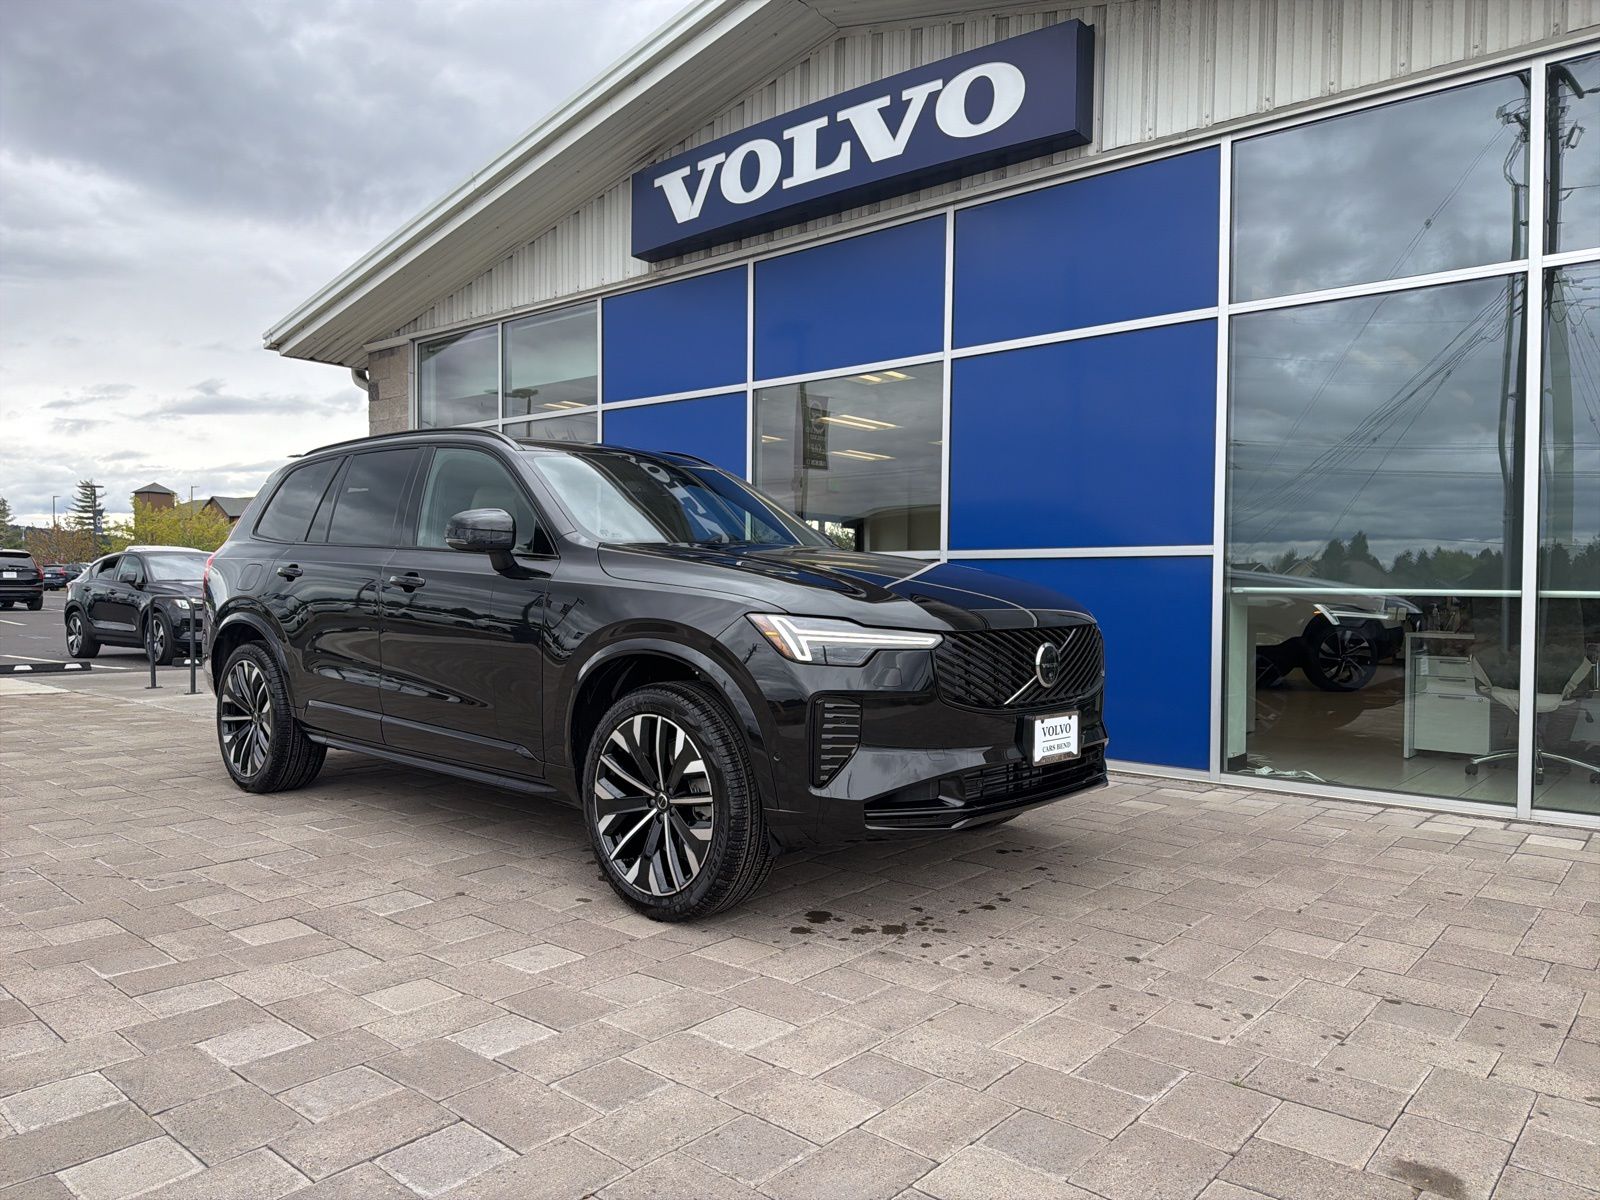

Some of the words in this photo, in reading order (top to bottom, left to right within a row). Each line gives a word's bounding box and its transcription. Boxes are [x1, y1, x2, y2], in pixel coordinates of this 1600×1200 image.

[654, 62, 1025, 224] VOLVO
[1042, 723, 1071, 737] VOLVO
[1042, 743, 1056, 753] CARS
[1056, 741, 1071, 751] BEND
